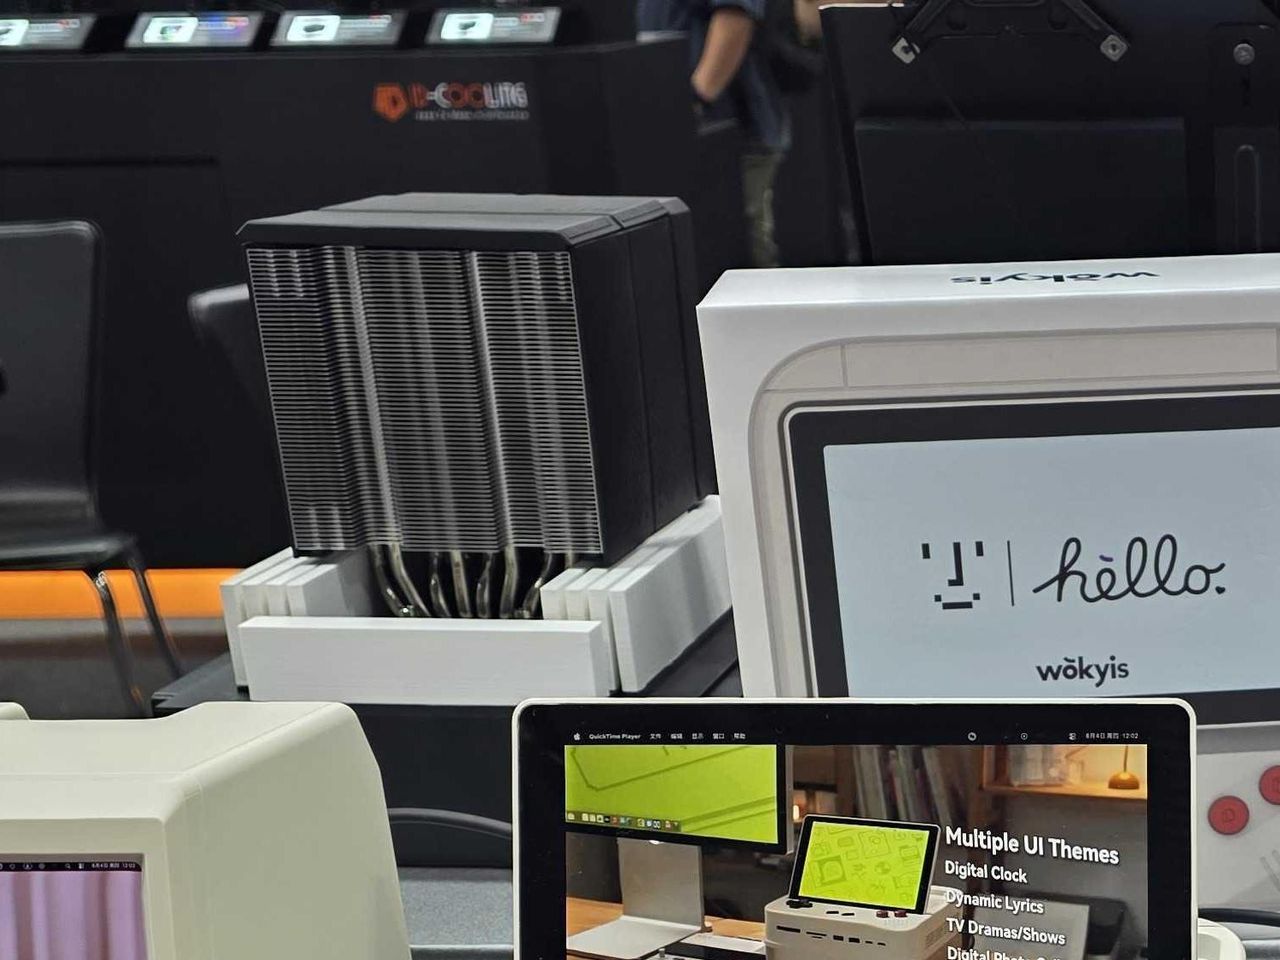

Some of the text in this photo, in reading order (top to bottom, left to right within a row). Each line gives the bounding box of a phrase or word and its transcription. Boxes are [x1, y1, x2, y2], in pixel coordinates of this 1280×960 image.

[946, 826, 1120, 865] Multiple UI Themes
[945, 860, 1028, 884] Digital Clock
[945, 890, 1044, 915] Dynamic Lyrics
[946, 918, 1066, 946] TV Dramas/Shows
